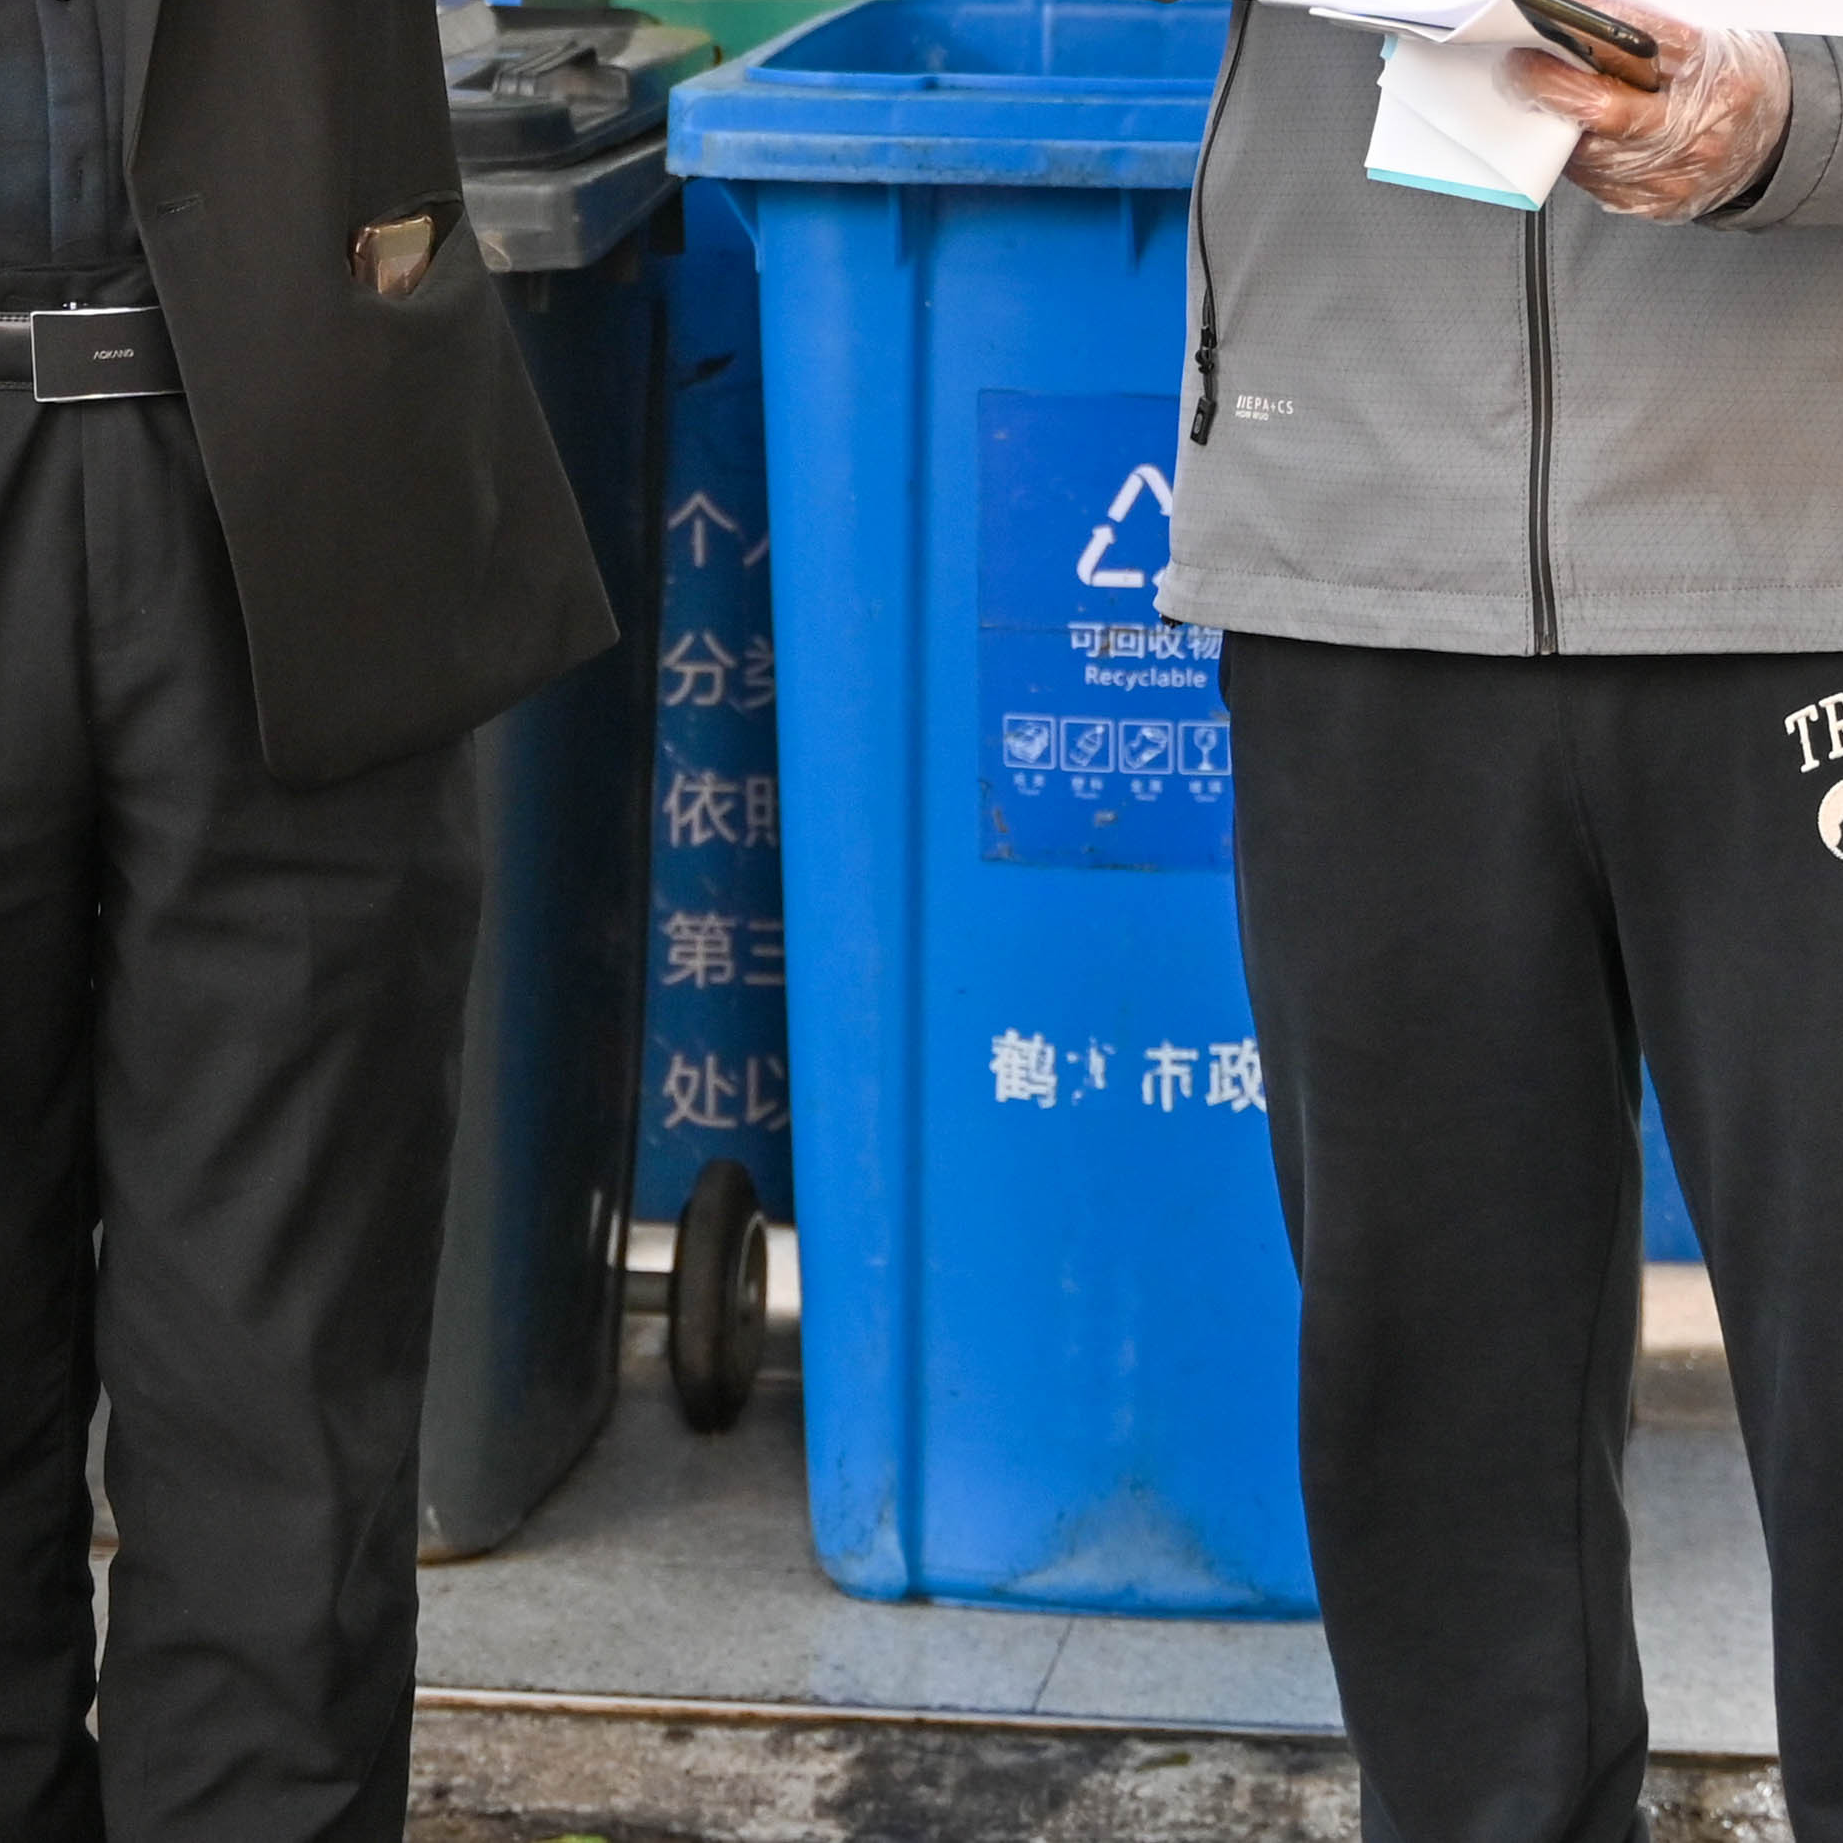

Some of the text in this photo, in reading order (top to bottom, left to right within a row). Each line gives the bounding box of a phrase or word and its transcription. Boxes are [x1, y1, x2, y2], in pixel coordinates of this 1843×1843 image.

[1066, 620, 1225, 660] 可回收物
[1084, 664, 1207, 692] Recyclable
[989, 1026, 1267, 1113] 鹤市政
